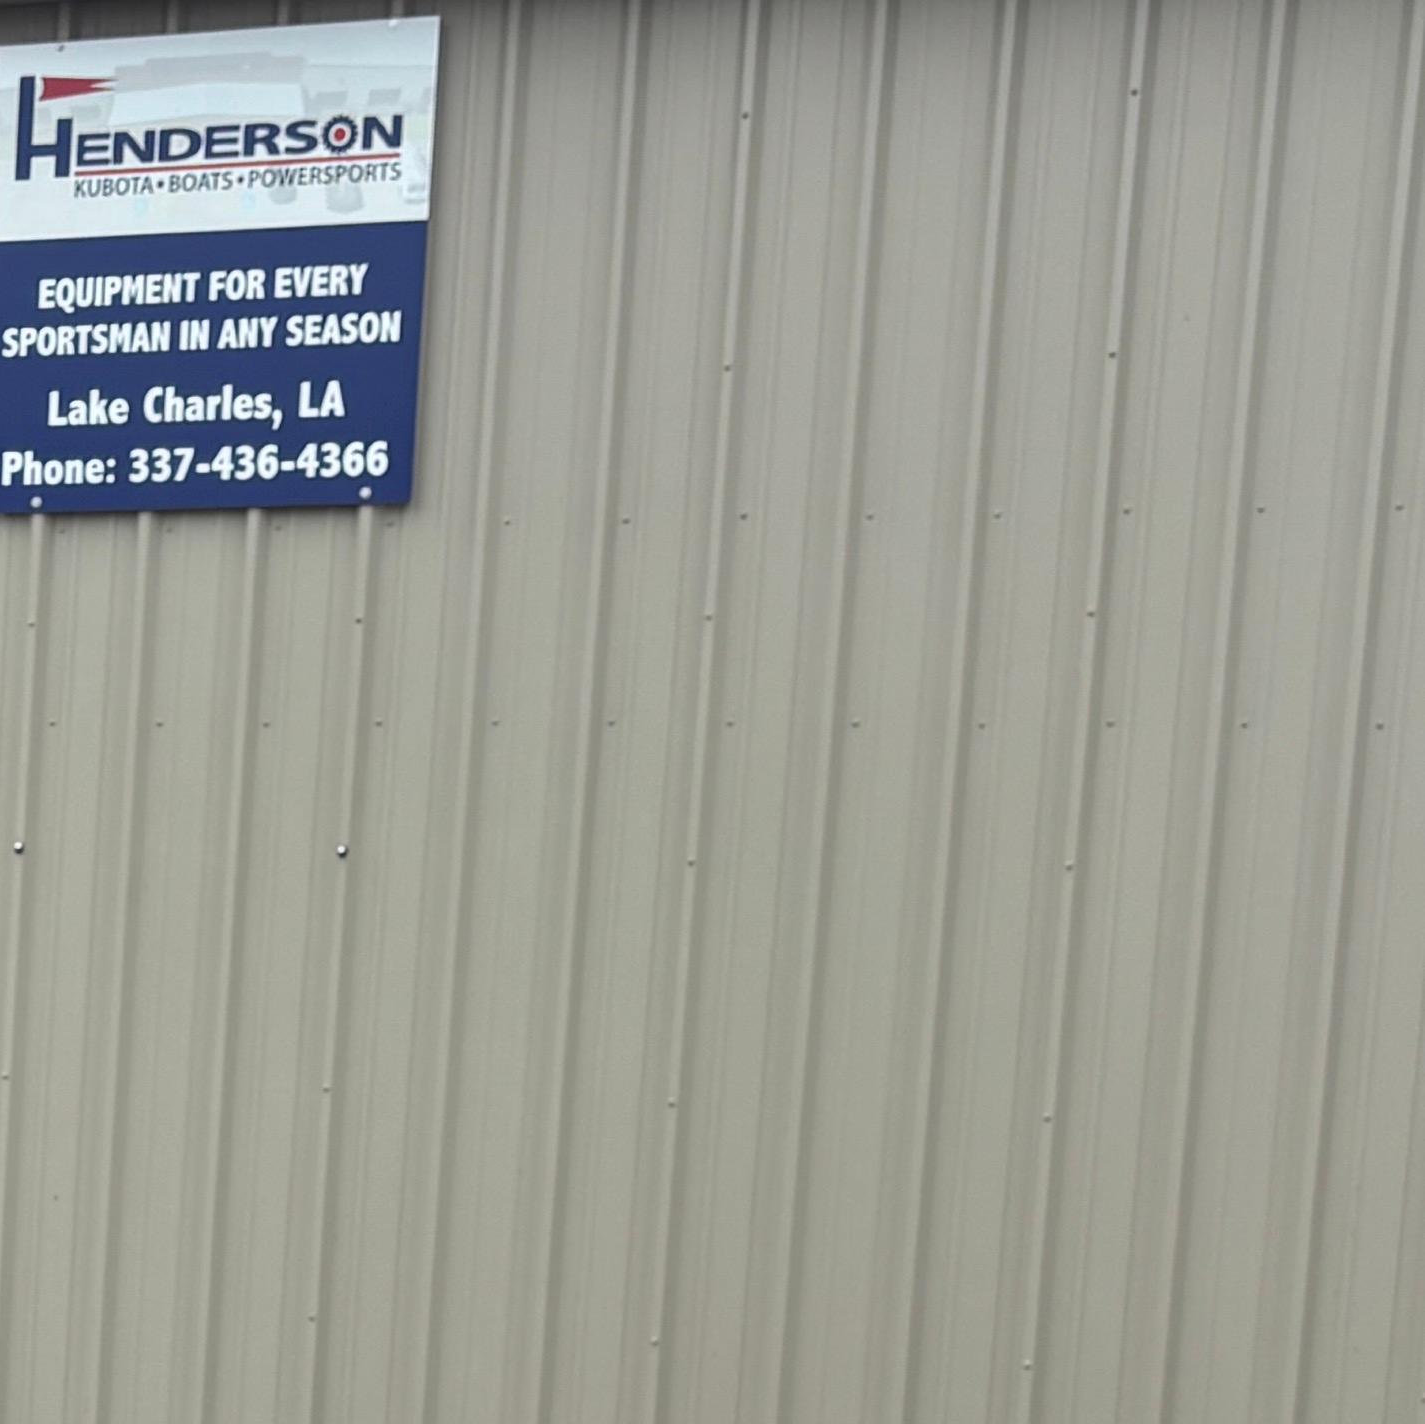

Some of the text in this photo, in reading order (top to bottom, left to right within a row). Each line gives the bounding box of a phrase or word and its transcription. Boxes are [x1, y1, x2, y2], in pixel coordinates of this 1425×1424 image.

[15, 75, 403, 181] HENDERSON
[74, 162, 402, 198] KUBOTA BOATS POWERSPORTS
[38, 263, 369, 314] EQUIPMENT FOR EVERY
[1, 310, 402, 358] SPORTSMAN IN ANY SEASON
[47, 380, 345, 431] Lake Charles, LA
[1, 440, 389, 486] Phone: 337-436-4366
